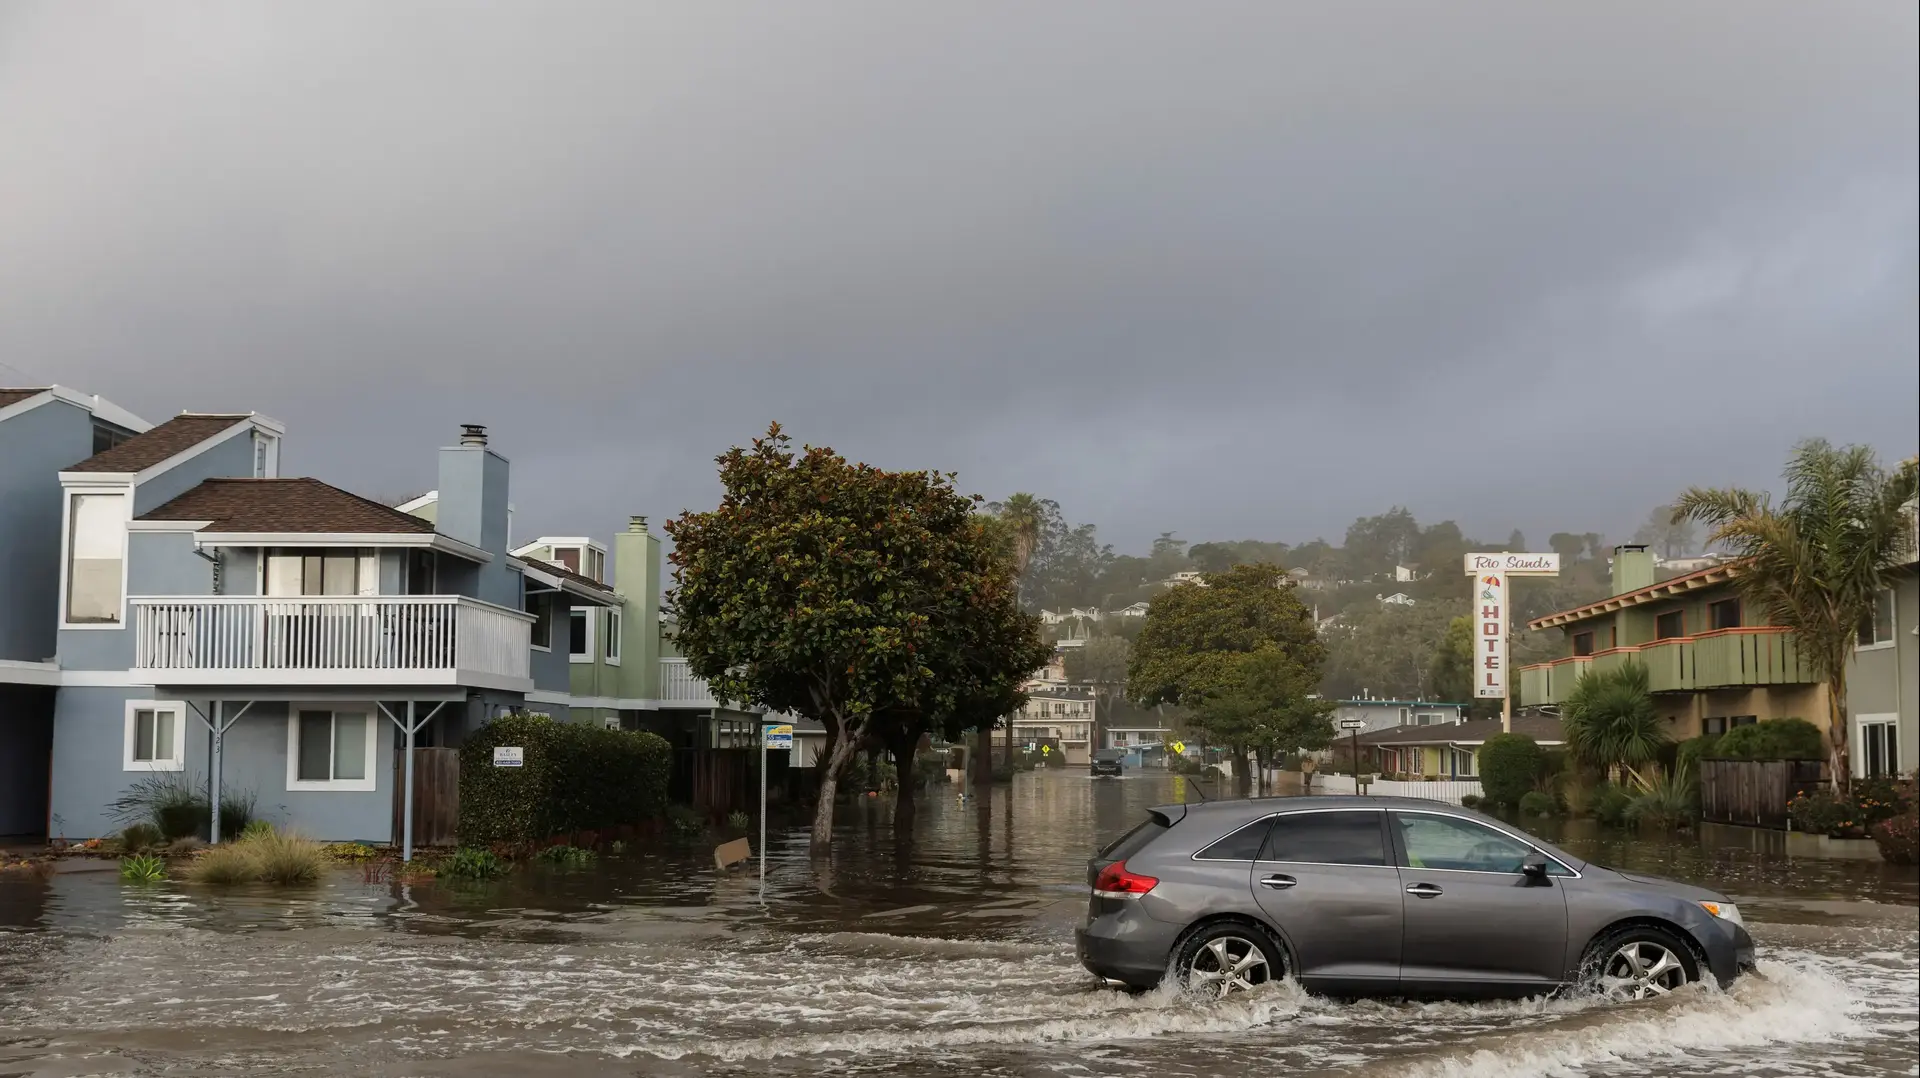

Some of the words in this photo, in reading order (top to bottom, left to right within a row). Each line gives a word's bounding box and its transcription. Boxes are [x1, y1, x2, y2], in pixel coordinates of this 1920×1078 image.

[1474, 555, 1499, 569] Rio
[1506, 555, 1552, 569] Sands
[1481, 605, 1499, 686] HOTEL
